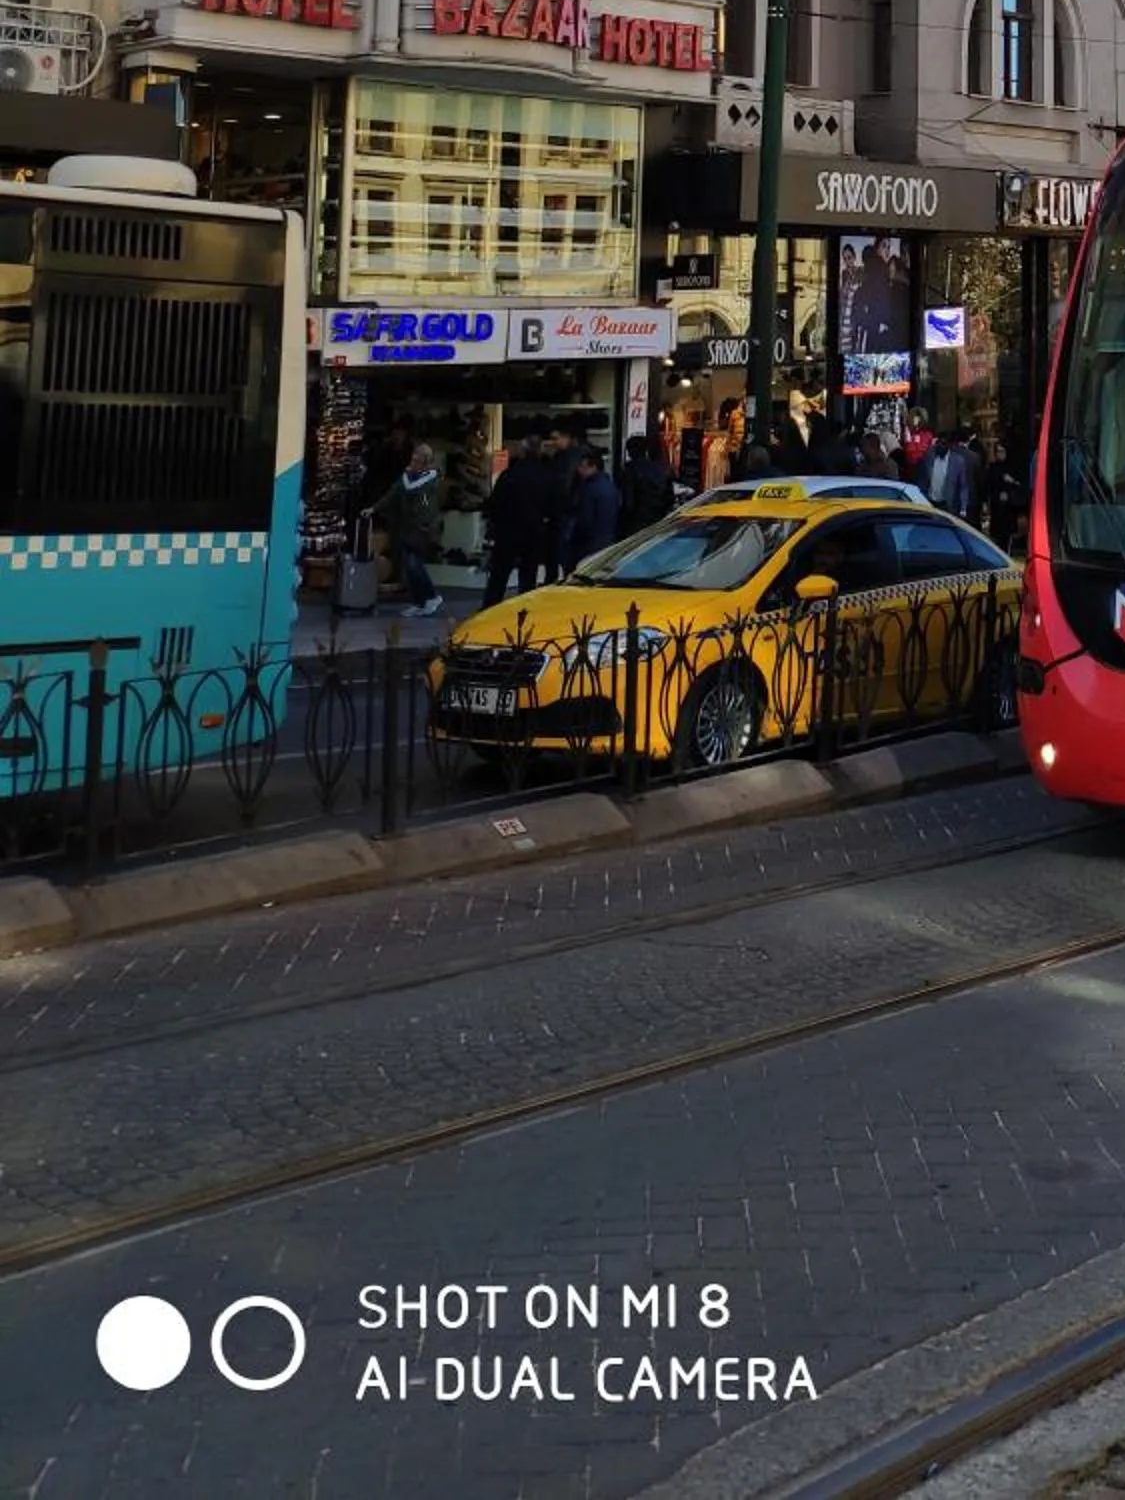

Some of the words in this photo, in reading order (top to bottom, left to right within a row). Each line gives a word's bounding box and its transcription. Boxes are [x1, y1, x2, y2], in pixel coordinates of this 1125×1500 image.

[601, 12, 711, 72] HOTEL
[421, 312, 494, 342] GOLD
[554, 315, 582, 337] La
[588, 314, 658, 337] Bazaar
